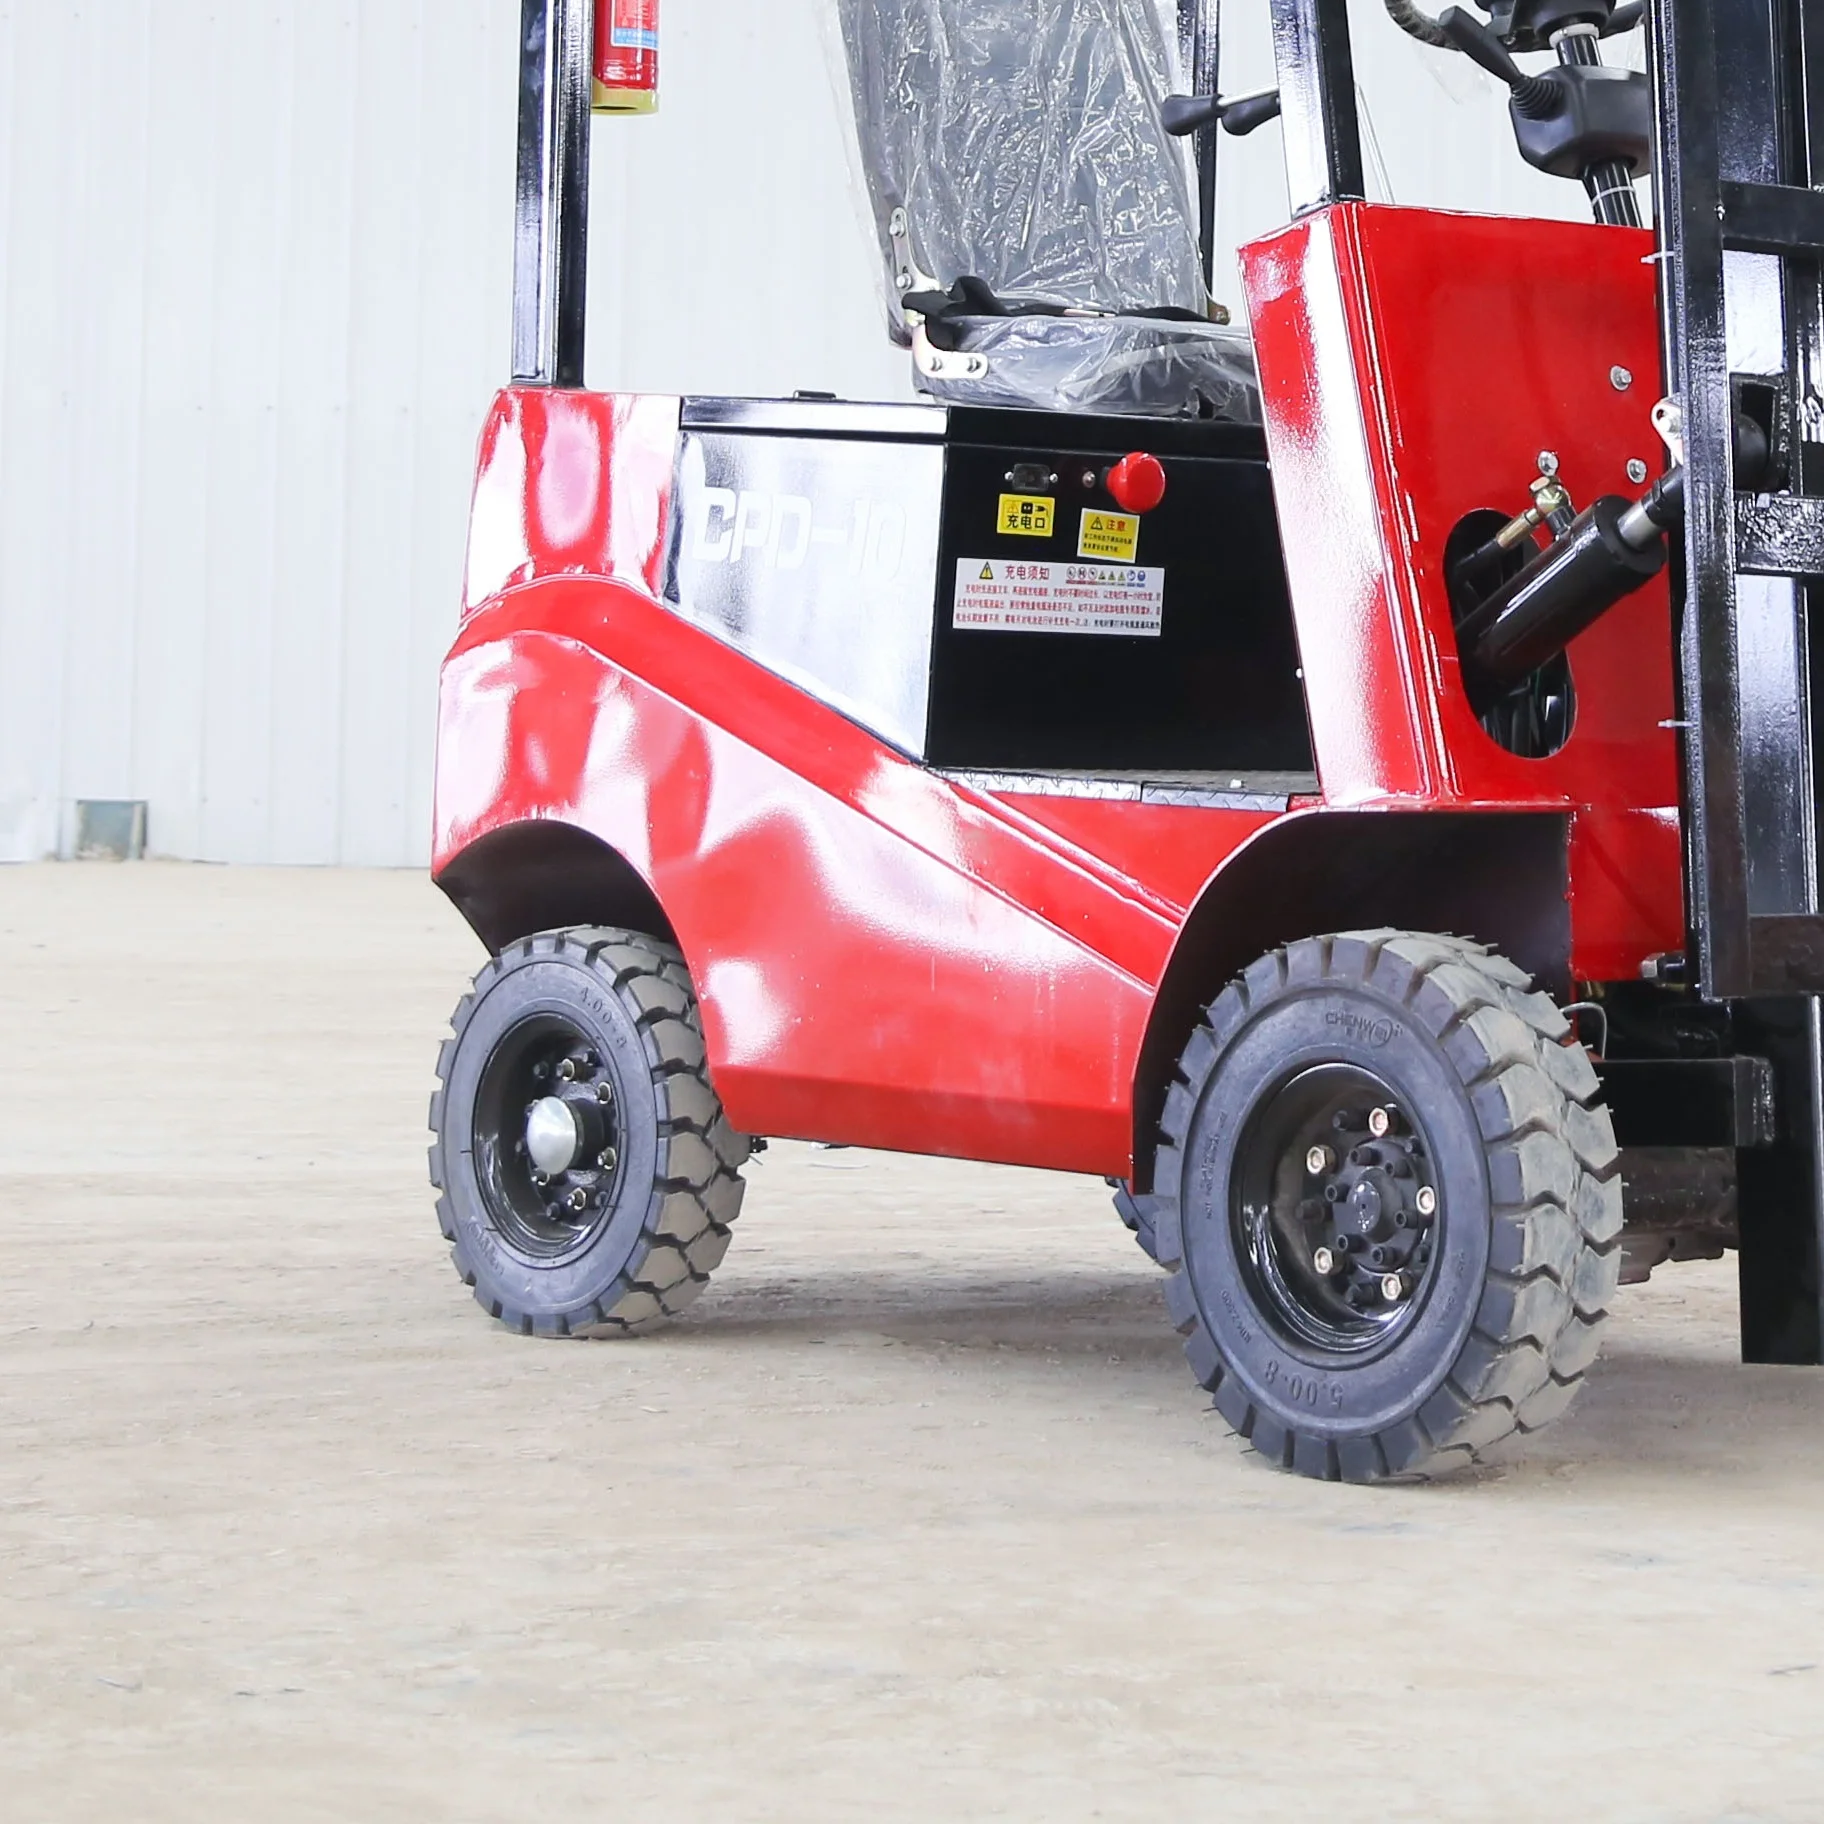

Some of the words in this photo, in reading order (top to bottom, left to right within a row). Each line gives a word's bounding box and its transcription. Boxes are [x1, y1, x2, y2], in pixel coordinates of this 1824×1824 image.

[1006, 514, 1045, 530] 充电口
[1104, 518, 1127, 532] 注意
[1005, 564, 1051, 581] 充电须知
[1264, 1359, 1343, 1411] 5.00-8
